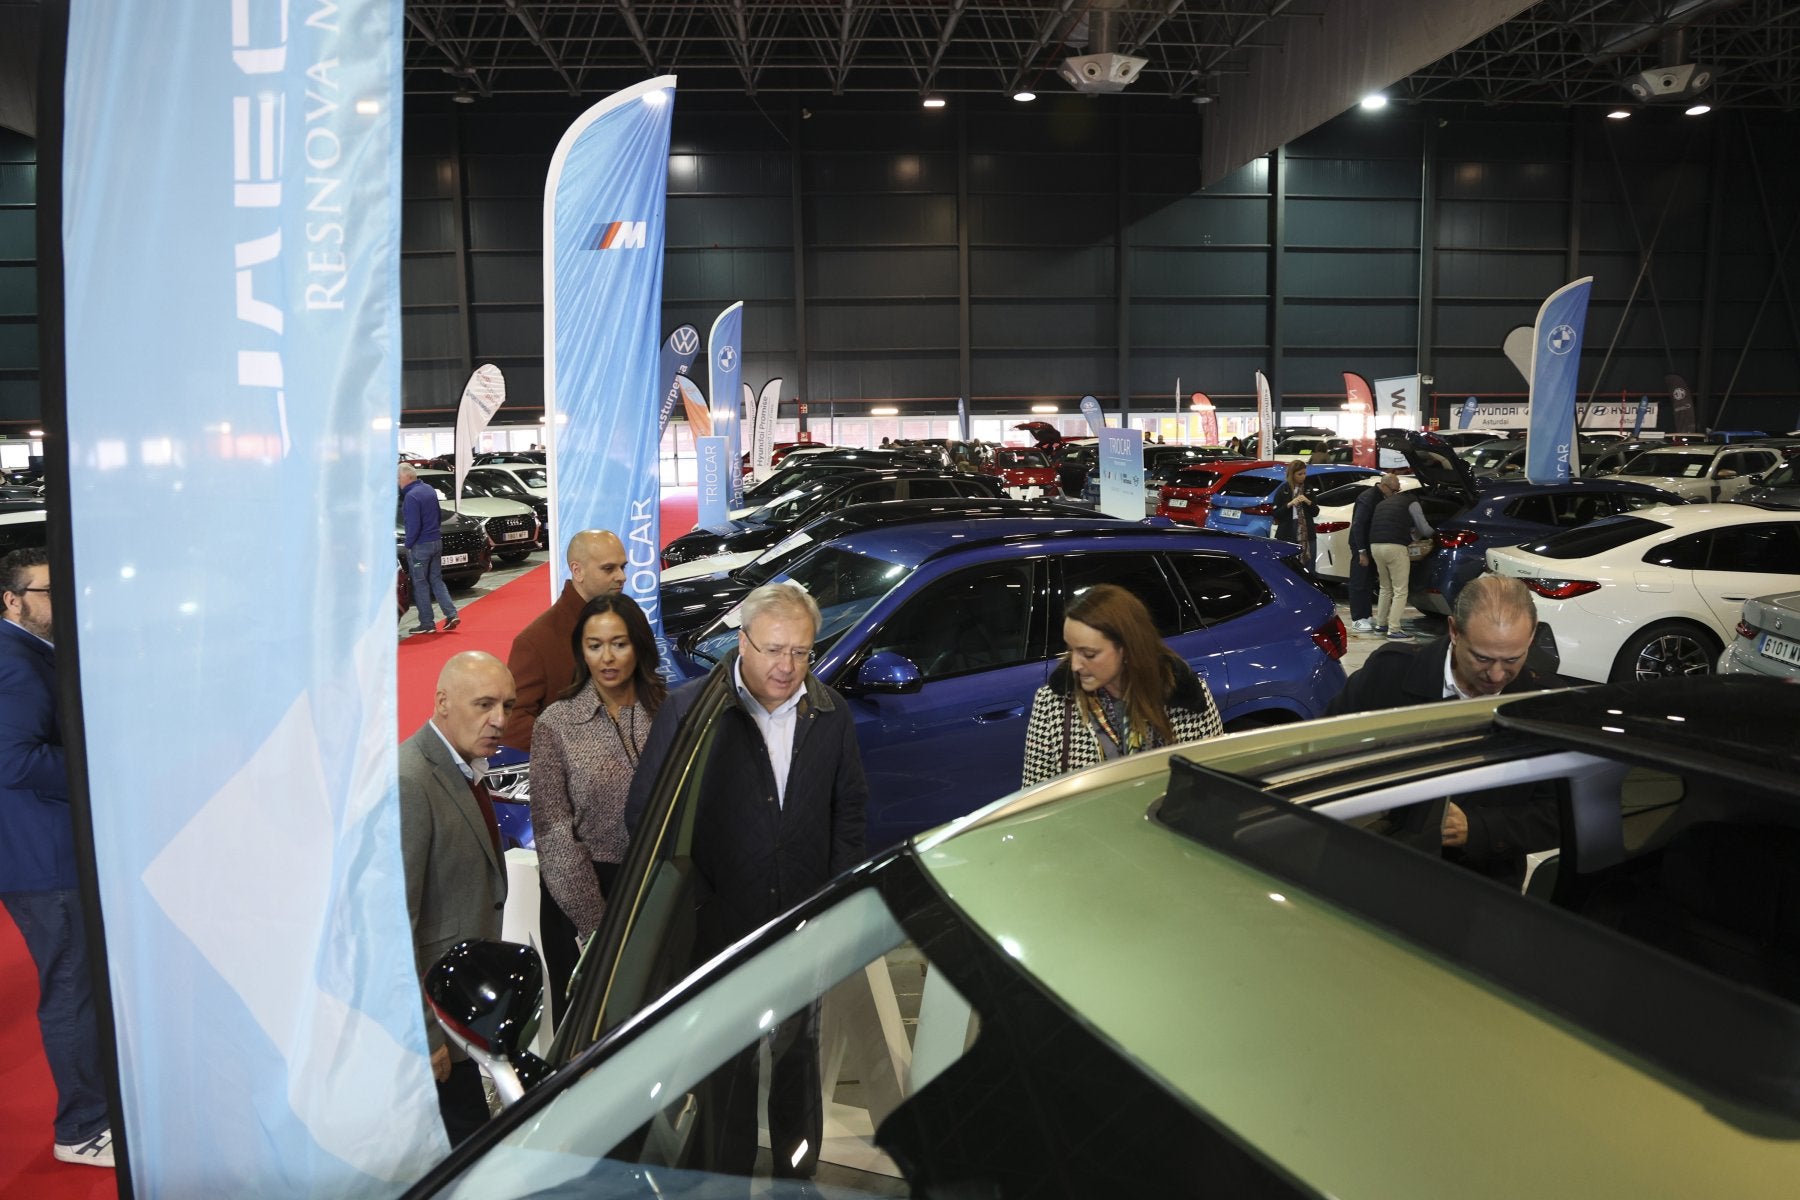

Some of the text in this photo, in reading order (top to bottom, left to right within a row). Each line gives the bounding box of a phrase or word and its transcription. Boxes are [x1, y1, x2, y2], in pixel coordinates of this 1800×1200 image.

[304, 57, 347, 312] RESNOVA
[759, 395, 769, 430] Promise
[705, 444, 718, 506] TRIOCAR
[1764, 638, 1789, 657] 6101
